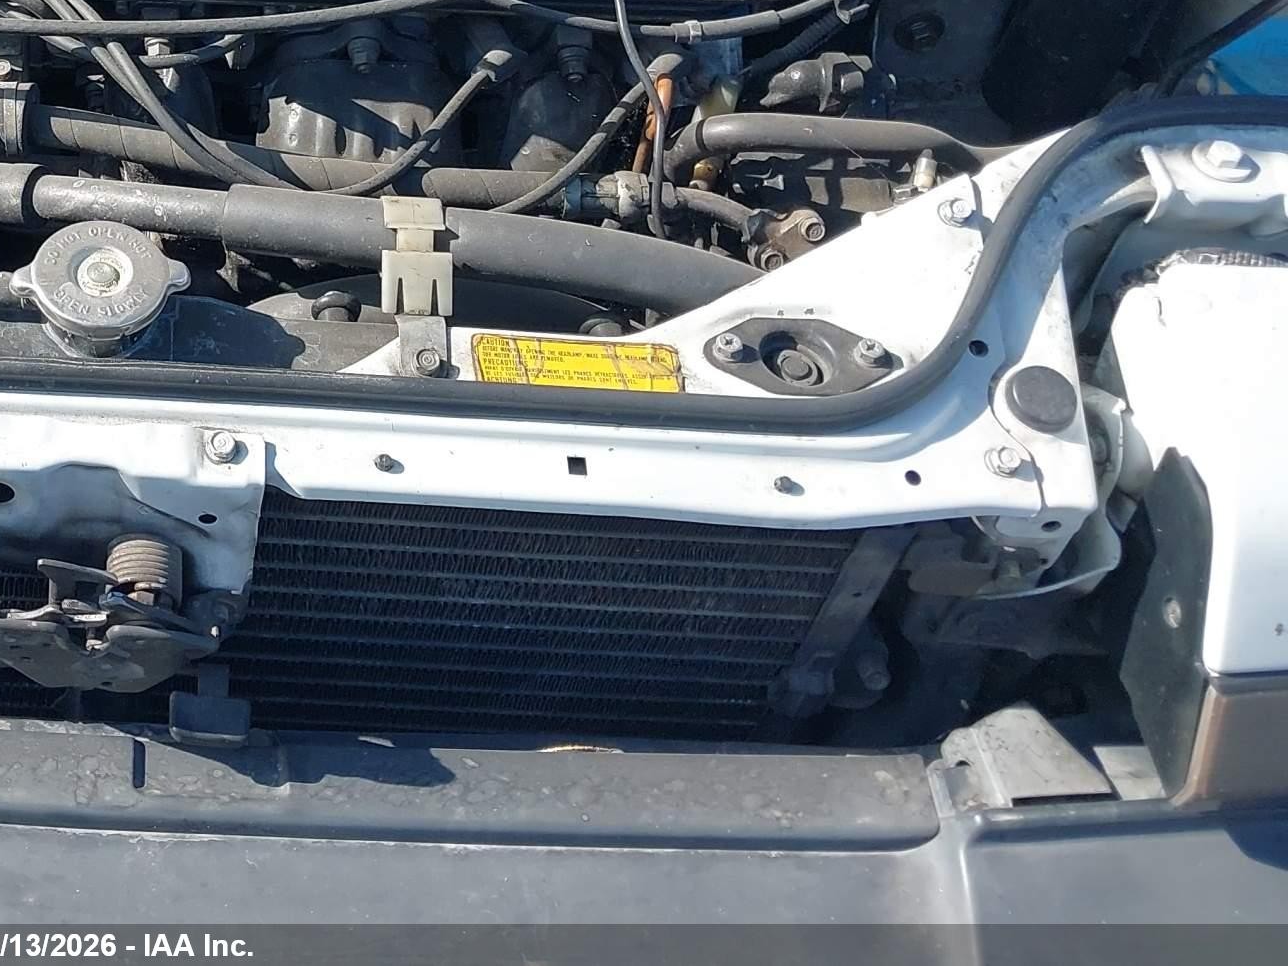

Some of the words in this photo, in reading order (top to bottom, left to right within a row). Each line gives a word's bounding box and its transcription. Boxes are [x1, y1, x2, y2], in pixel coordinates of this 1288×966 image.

[88, 226, 127, 242] OPEN
[53, 291, 91, 315] OPEN
[97, 289, 151, 317] SLOWLY
[481, 336, 510, 347] CAUTION
